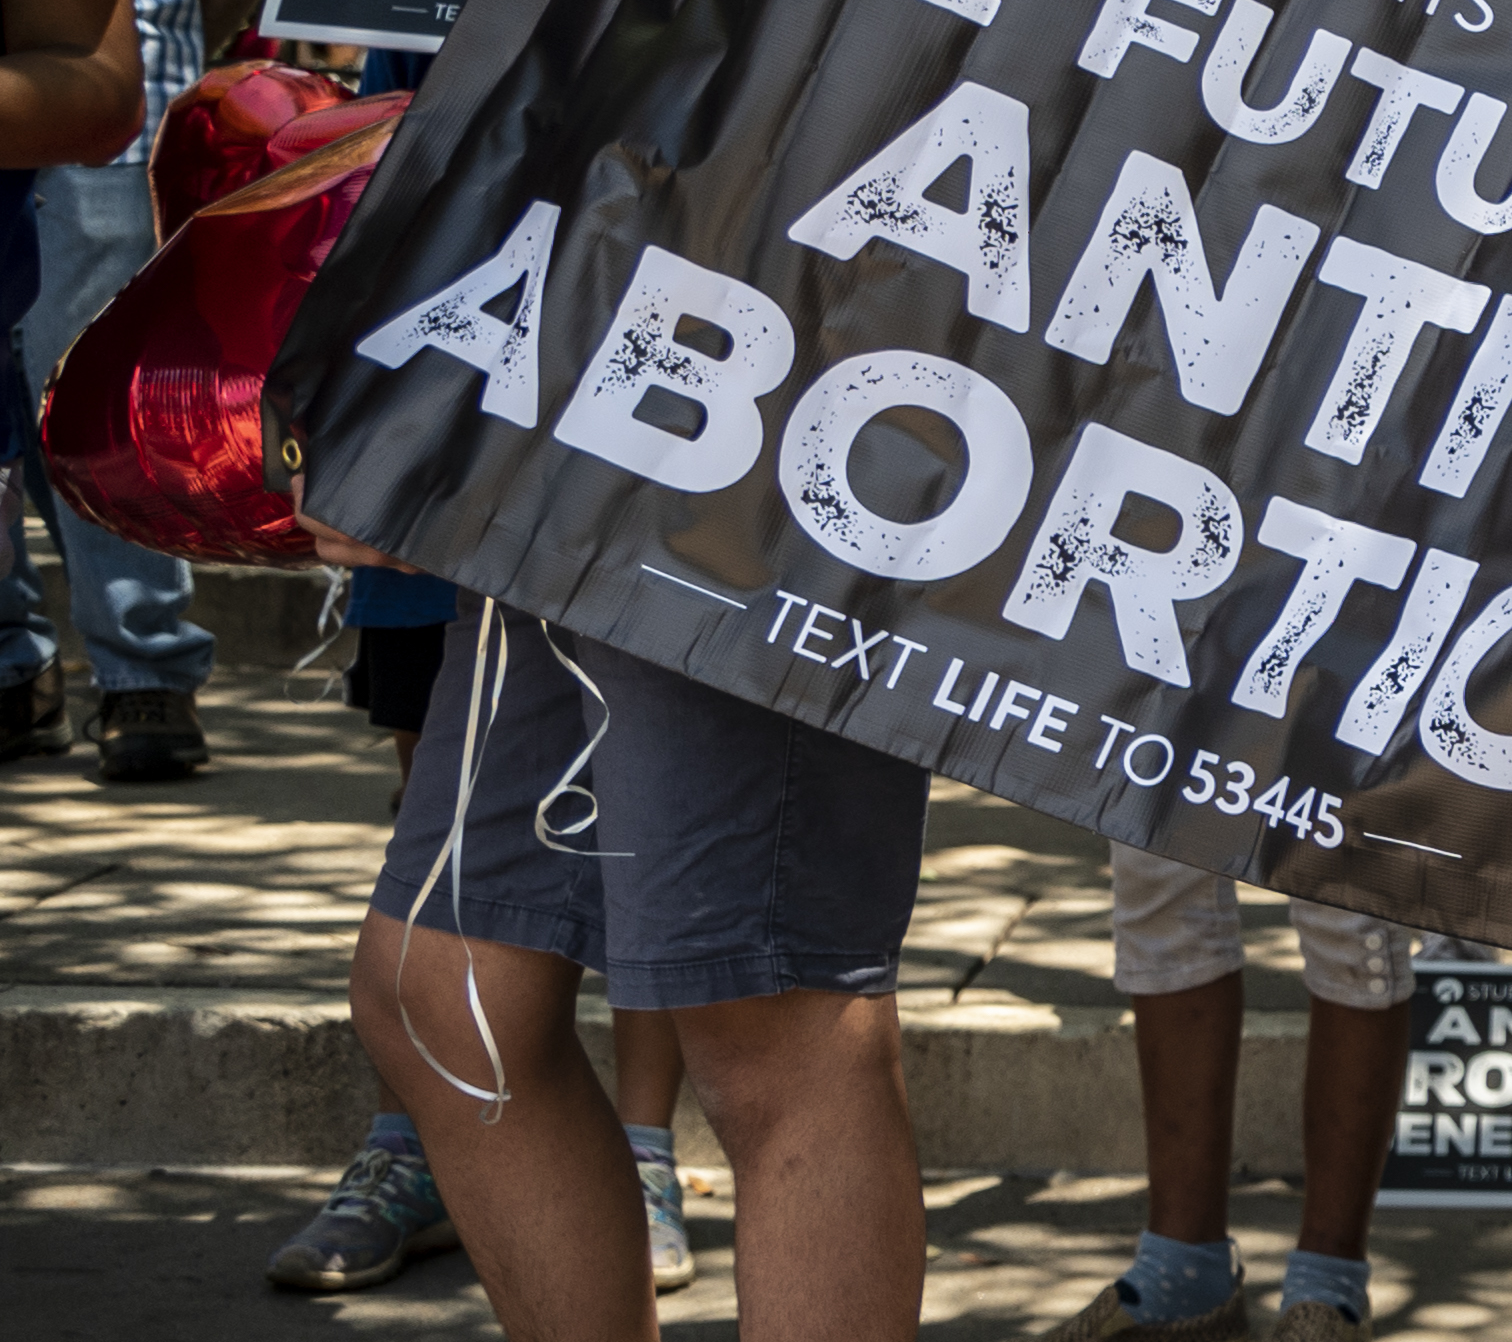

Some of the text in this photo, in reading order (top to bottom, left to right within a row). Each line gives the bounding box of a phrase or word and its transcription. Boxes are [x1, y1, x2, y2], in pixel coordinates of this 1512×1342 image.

[766, 590, 1345, 850] TEXT LIFE TO 53445
